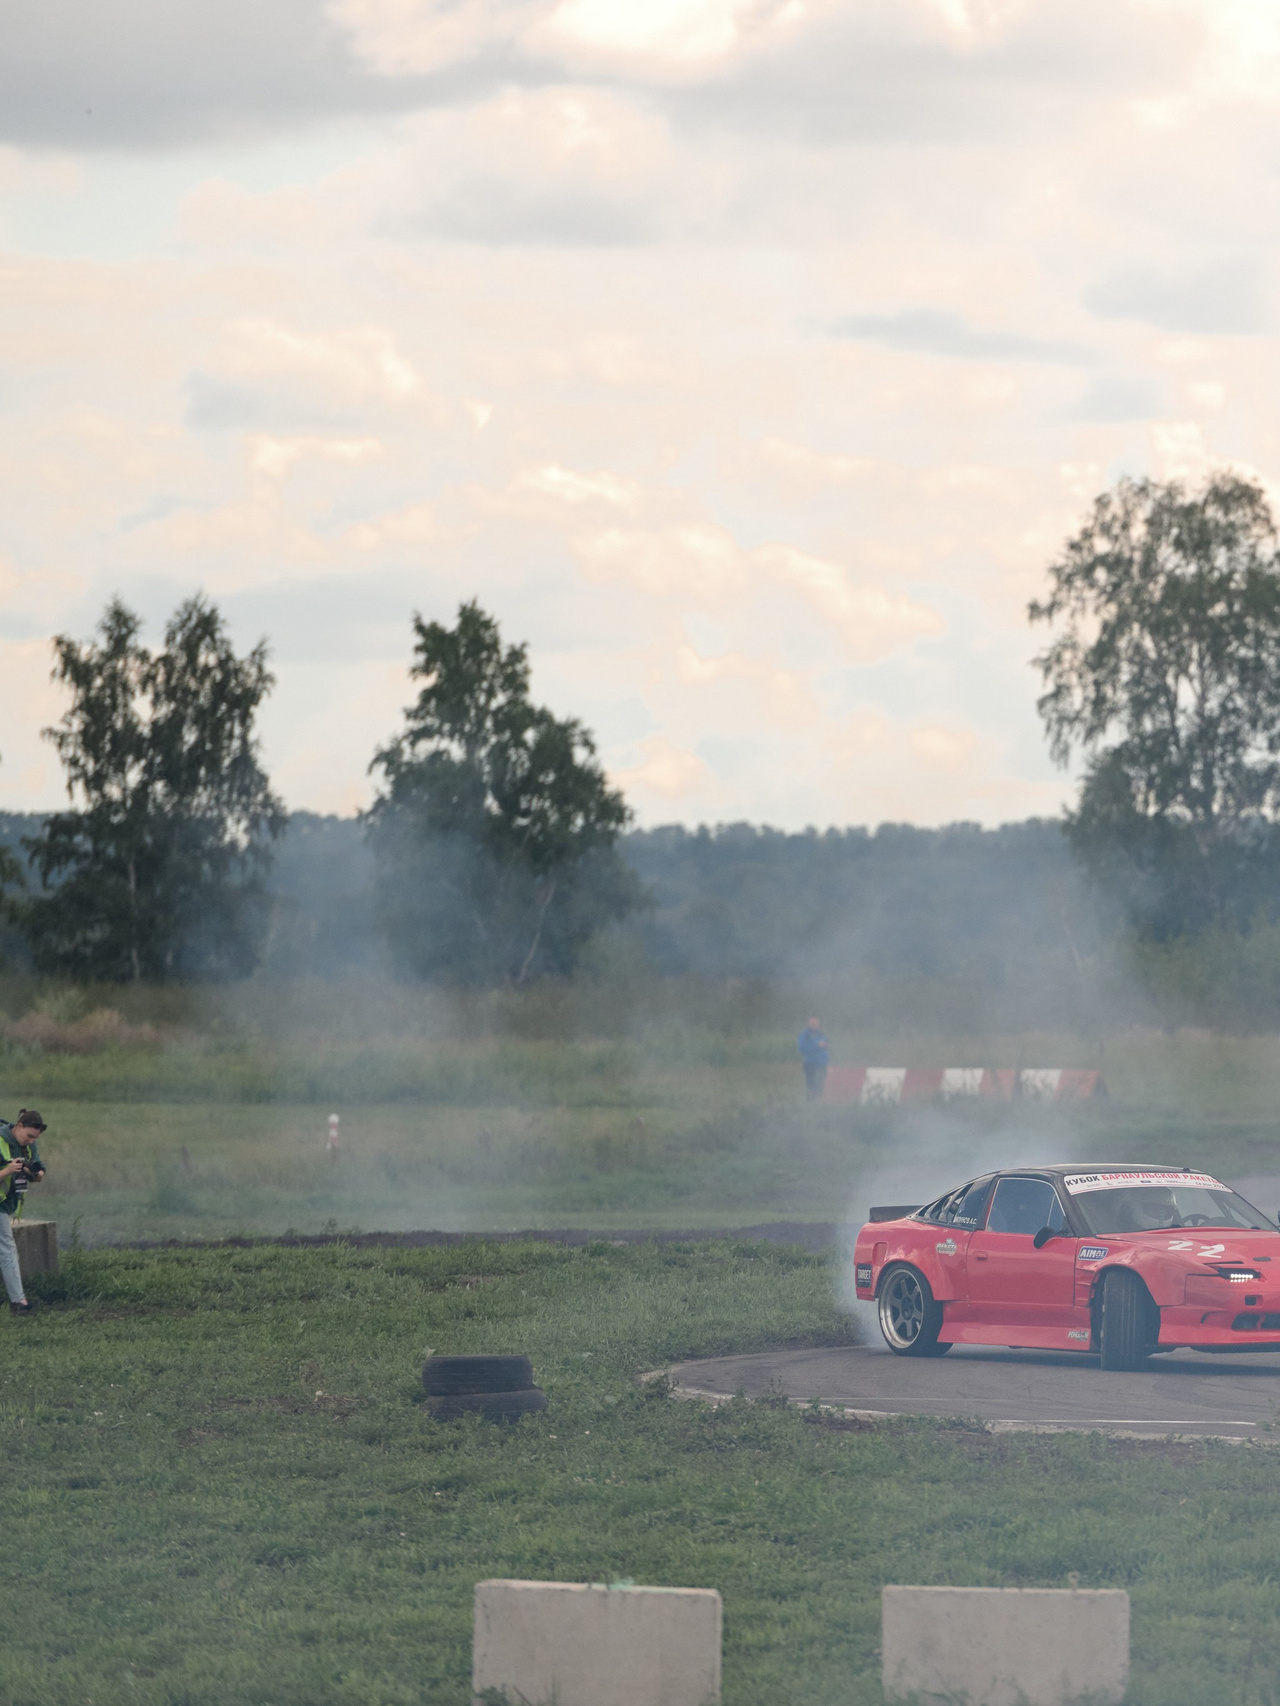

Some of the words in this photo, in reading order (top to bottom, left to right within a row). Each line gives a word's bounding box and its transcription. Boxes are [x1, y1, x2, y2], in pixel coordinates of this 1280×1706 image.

[1065, 1175, 1100, 1186] КУБОК
[1080, 1249, 1104, 1258] AIMOL
[1168, 1240, 1225, 1258] 22
[857, 1269, 871, 1279] TARGET
